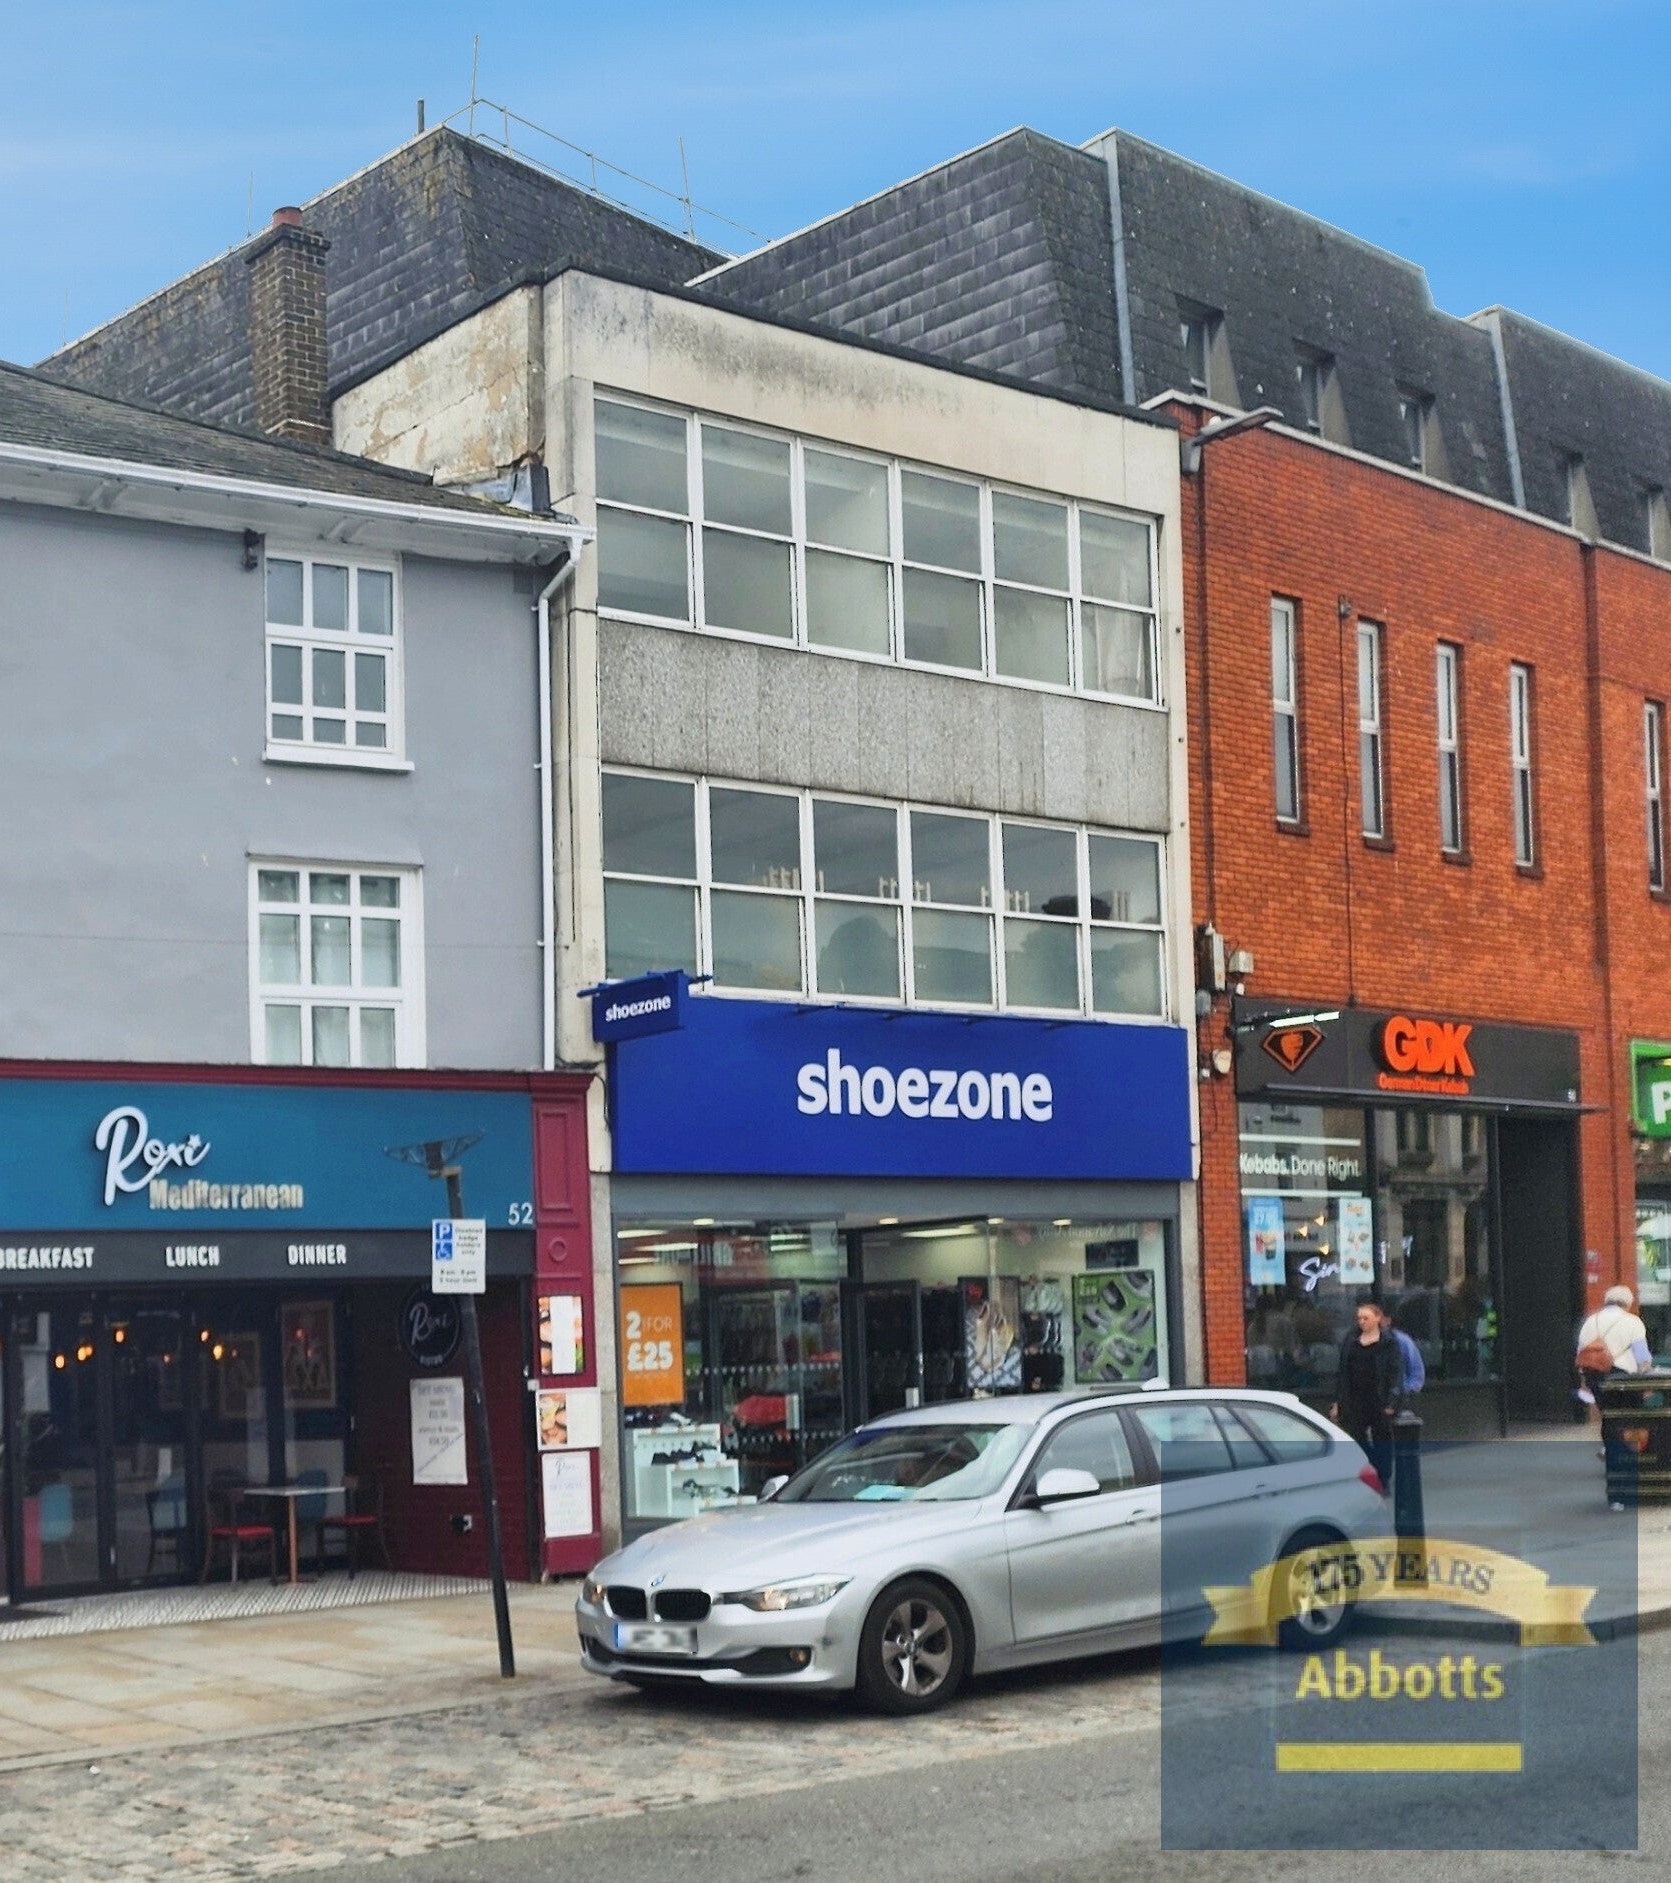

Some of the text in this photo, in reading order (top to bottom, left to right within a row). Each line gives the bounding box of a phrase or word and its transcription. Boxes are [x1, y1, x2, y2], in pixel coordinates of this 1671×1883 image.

[606, 995, 671, 1022] shoezone
[1384, 1015, 1475, 1077] GDK
[796, 1047, 1053, 1122] shoezone
[95, 1105, 211, 1206] Roxi
[1291, 1154, 1326, 1177] Done
[149, 1178, 304, 1211] Mediterranean
[508, 1202, 533, 1226] 52
[439, 1225, 450, 1239] P
[165, 1246, 220, 1267] LUNCH
[287, 1244, 347, 1265] DINNER
[626, 1310, 673, 1339] 2 FOR
[627, 1341, 674, 1371] £25
